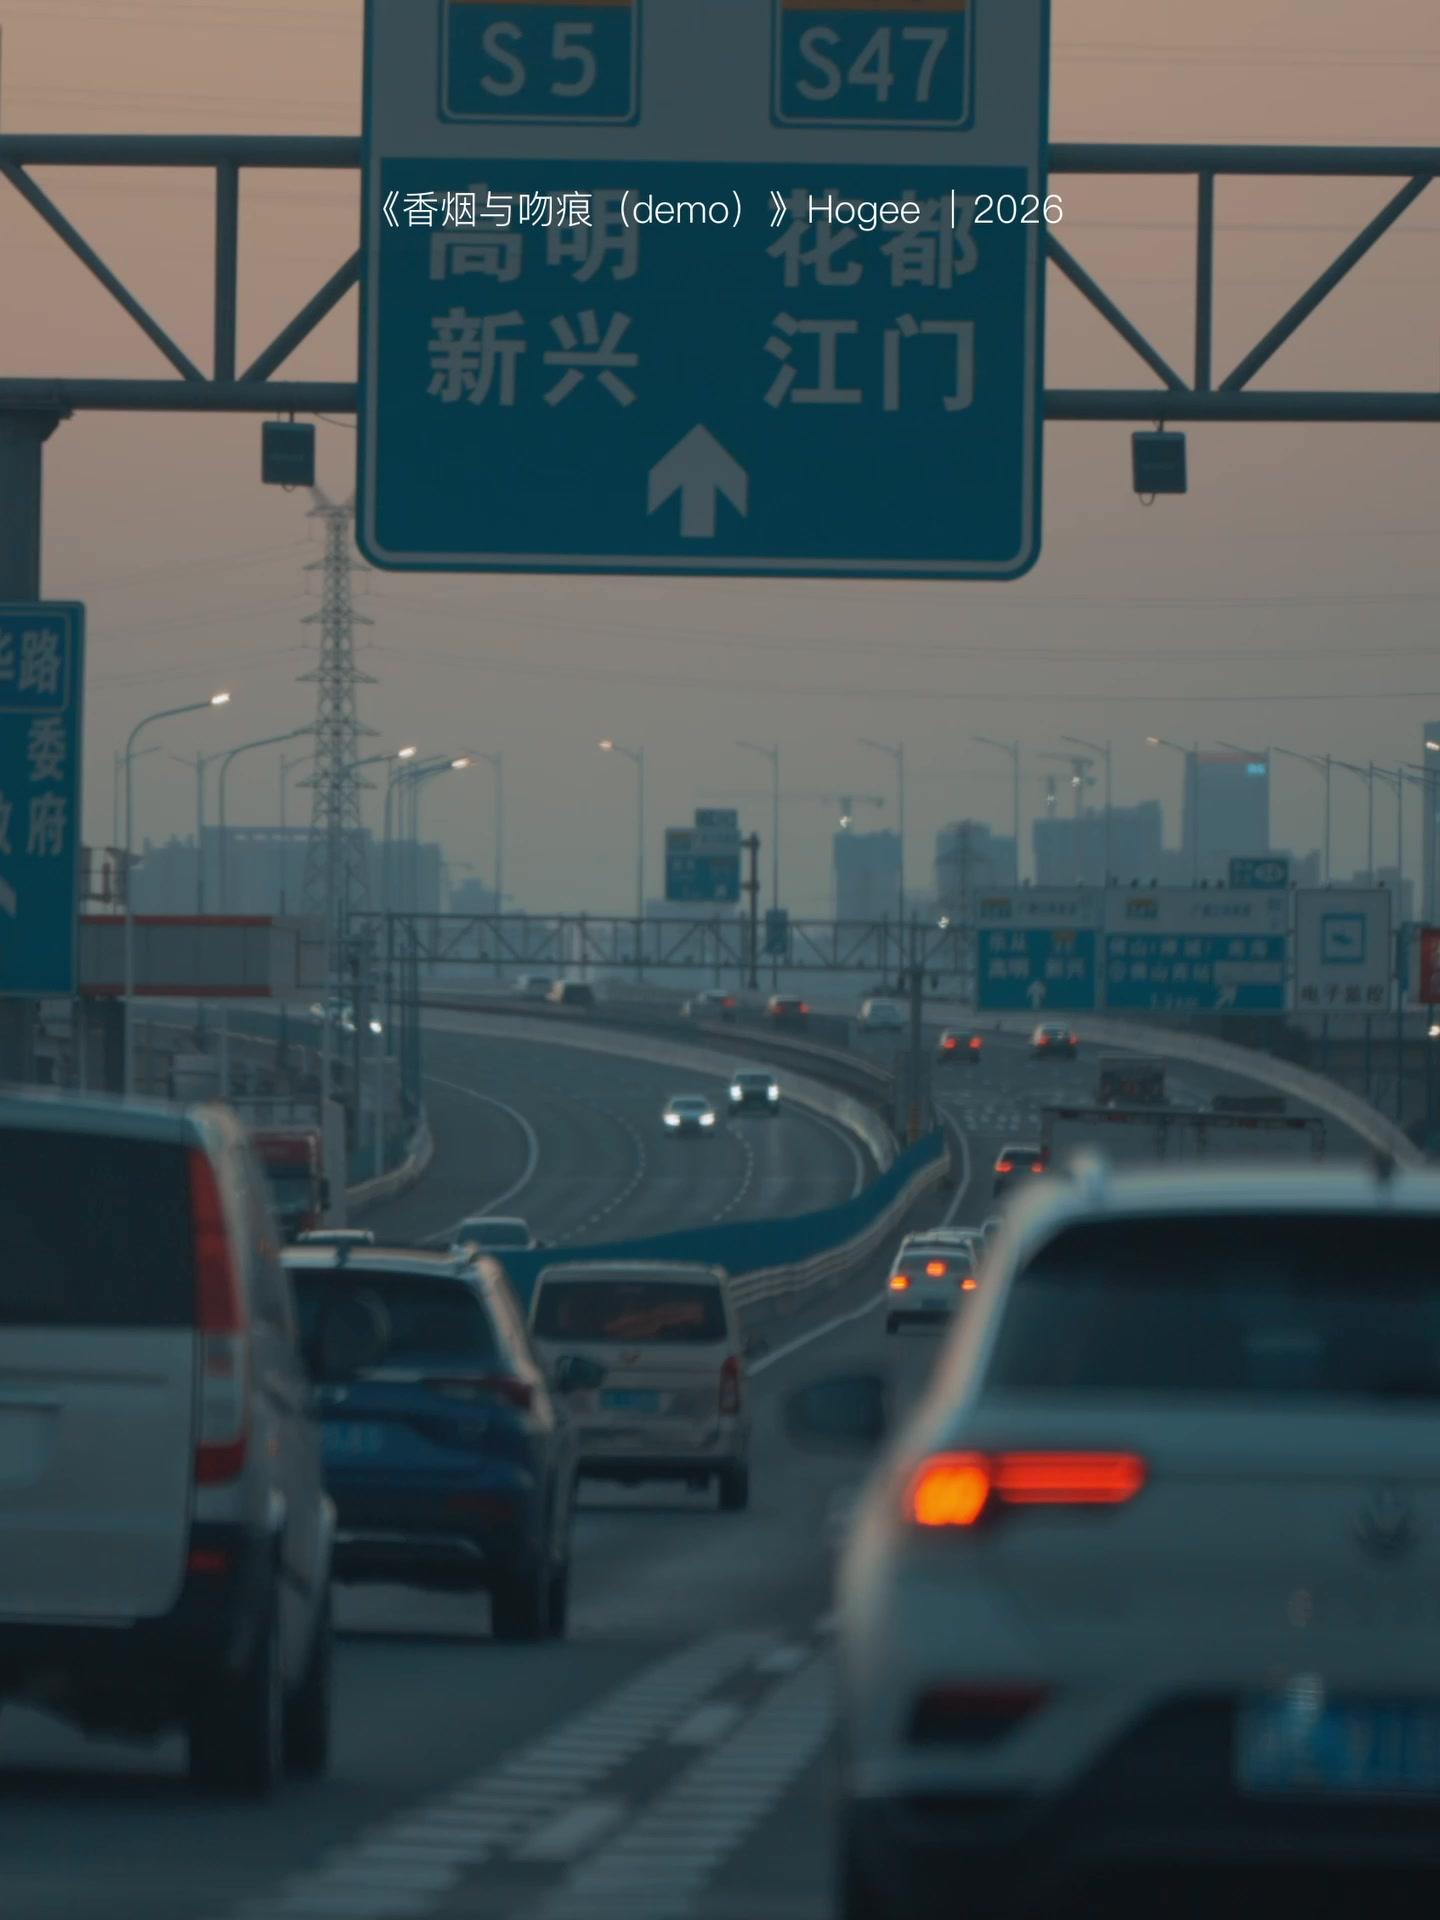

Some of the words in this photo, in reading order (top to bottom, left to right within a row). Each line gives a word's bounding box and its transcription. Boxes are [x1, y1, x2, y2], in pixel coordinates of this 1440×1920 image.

[795, 26, 949, 103] S47
[429, 183, 640, 284] 高明
[767, 187, 980, 289] 花都
[426, 306, 638, 408] 新兴
[763, 311, 976, 413] 江门
